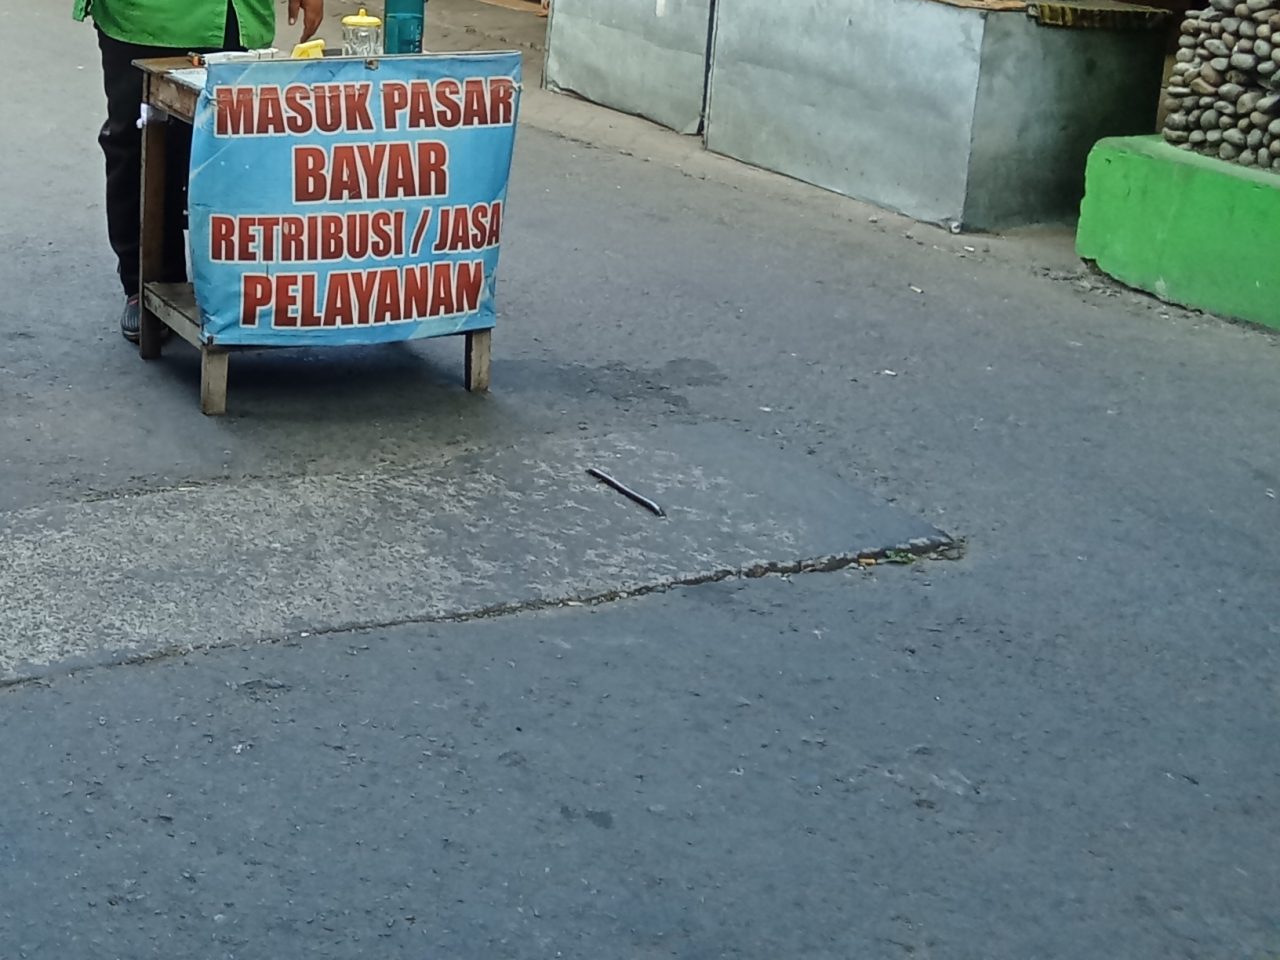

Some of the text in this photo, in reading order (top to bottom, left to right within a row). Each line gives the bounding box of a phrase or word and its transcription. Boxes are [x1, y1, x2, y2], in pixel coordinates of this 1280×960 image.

[215, 78, 513, 135] MASUK PASAR
[294, 142, 447, 202] BAYAR
[211, 211, 404, 261] RETRIBUSI
[434, 204, 501, 252] JASA
[241, 261, 484, 327] PELAYANAN
